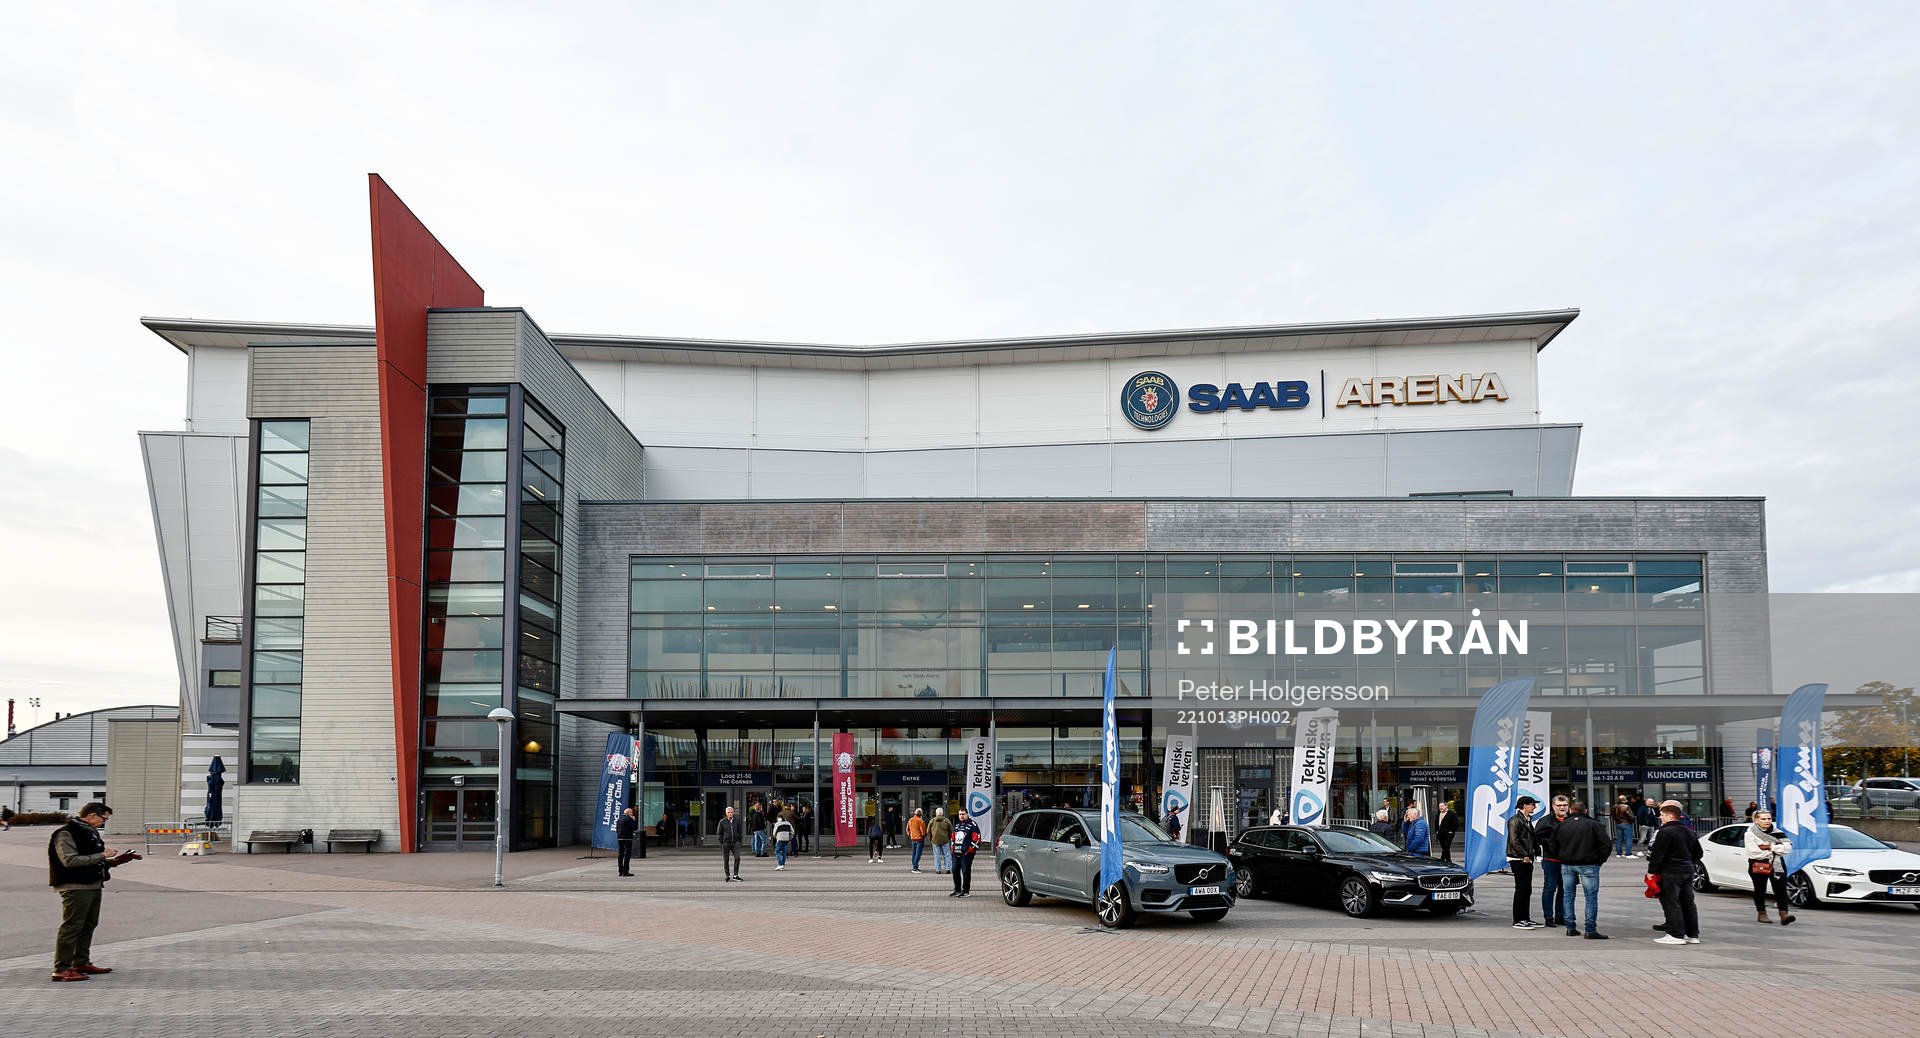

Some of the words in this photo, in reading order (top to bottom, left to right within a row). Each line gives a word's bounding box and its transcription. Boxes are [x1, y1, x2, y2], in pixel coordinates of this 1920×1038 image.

[1136, 376, 1164, 387] SAAB
[1188, 380, 1311, 414] SAAB
[1336, 371, 1510, 408] ARENA
[1133, 409, 1168, 423] TECHNOLOGIES
[973, 743, 985, 788] Tekniska
[984, 752, 992, 788] verken
[1169, 741, 1183, 786] Tekniska
[1181, 750, 1192, 787] verken
[1301, 719, 1319, 784] Tekniska
[1530, 733, 1544, 784] verken
[614, 779, 623, 800] Club
[1647, 771, 1707, 779] KUNDCENTER
[603, 783, 615, 826] Linköping
